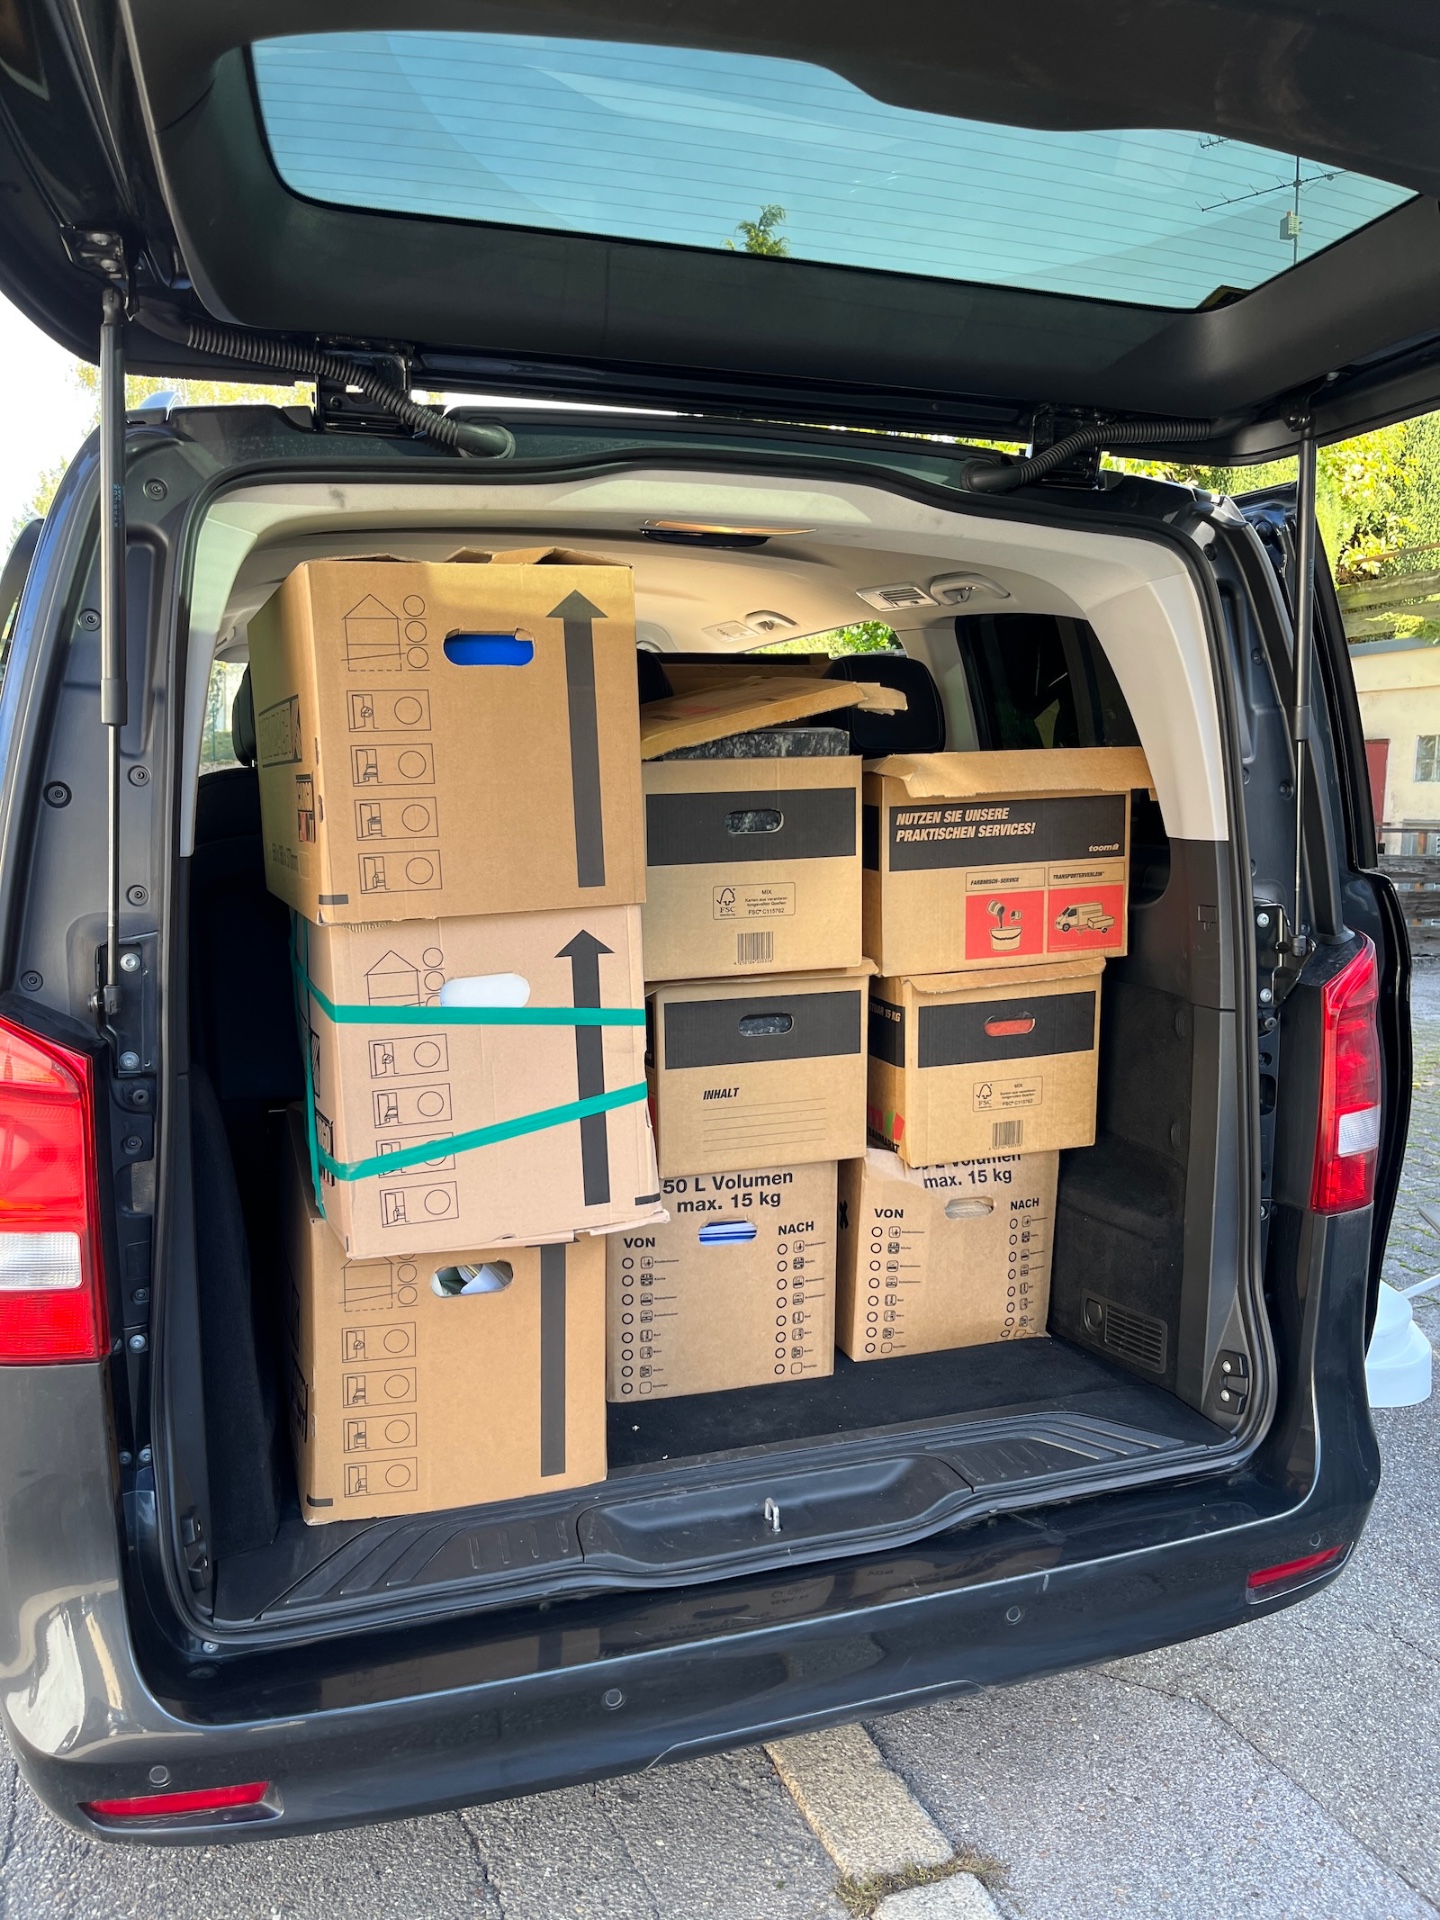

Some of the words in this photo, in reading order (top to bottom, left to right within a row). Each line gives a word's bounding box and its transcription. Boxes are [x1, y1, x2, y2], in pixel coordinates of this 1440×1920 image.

[896, 811, 941, 826] NUTZEN
[943, 810, 962, 823] SIE
[965, 807, 1010, 822] UNSERE
[896, 826, 975, 842] PRAKTISCHEN
[977, 822, 1036, 838] SERVICES!
[1088, 843, 1111, 852] toom
[703, 1087, 740, 1101] INHALT
[662, 1178, 688, 1194] 50
[694, 1178, 706, 1192] L
[711, 1172, 793, 1191] Volumen
[924, 1174, 962, 1188] max.
[968, 1170, 987, 1184] 15
[993, 1168, 1012, 1184] kg
[676, 1198, 723, 1213] max.
[731, 1193, 753, 1208] 15
[759, 1191, 782, 1207] kg
[1010, 1197, 1040, 1211] NACH
[874, 1208, 904, 1219] VON
[778, 1220, 815, 1236] NACH
[623, 1237, 656, 1248] VON
